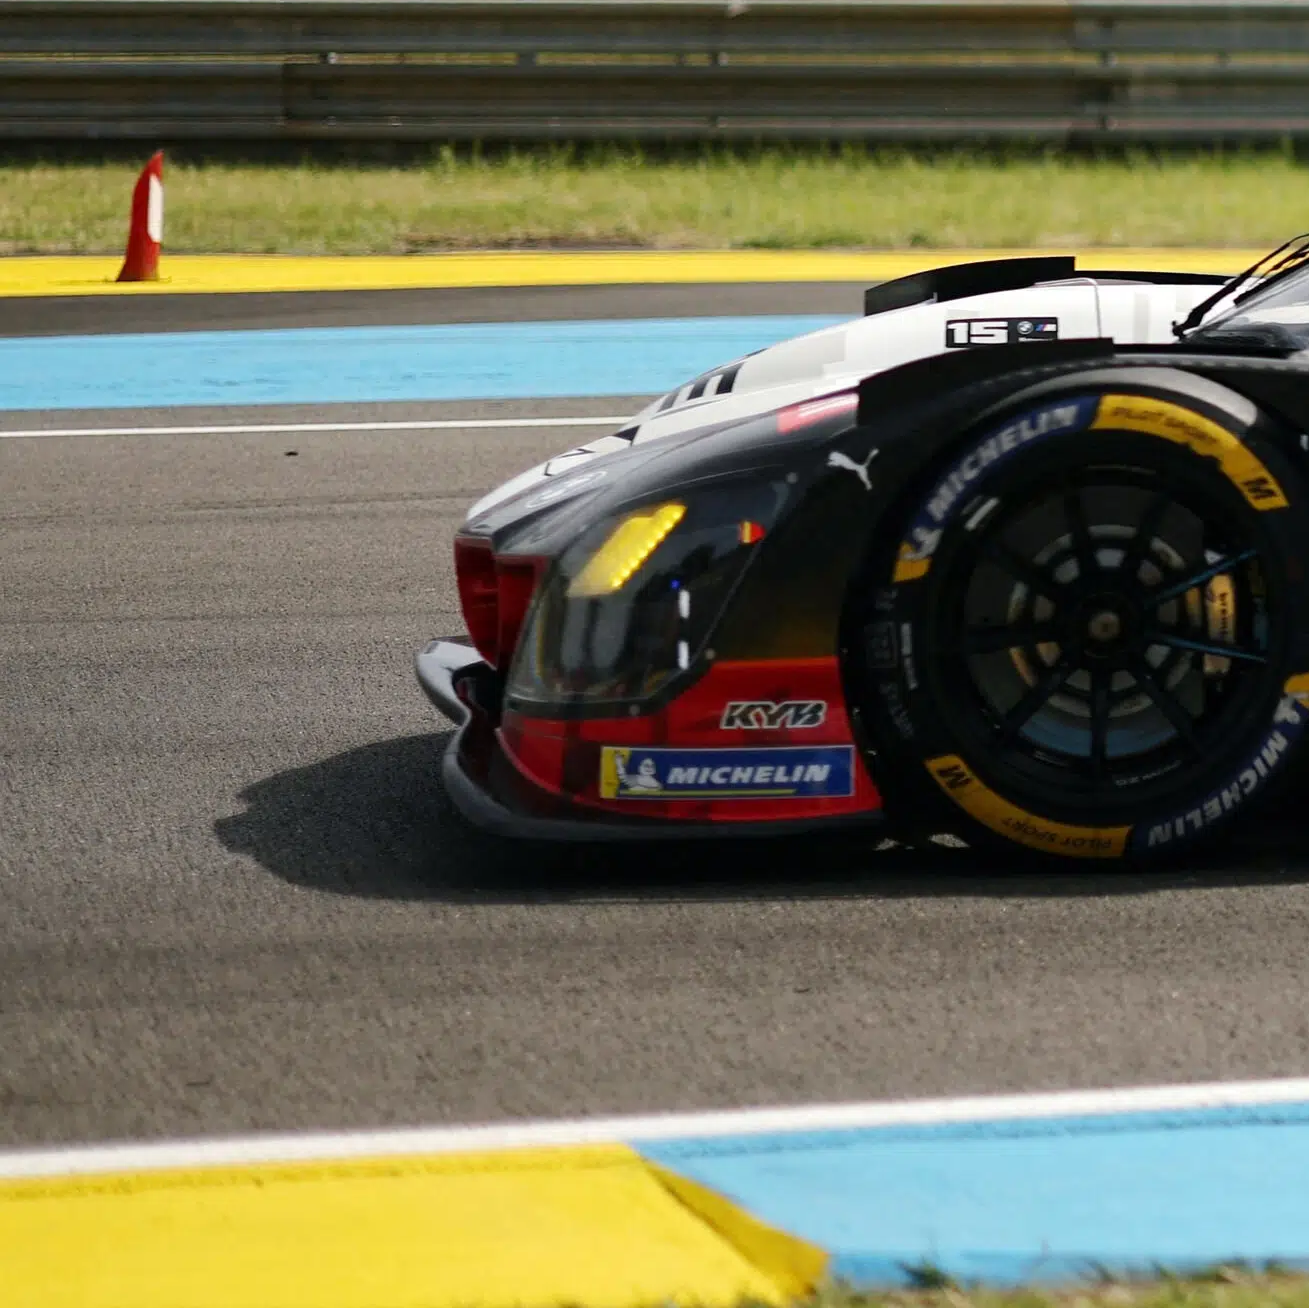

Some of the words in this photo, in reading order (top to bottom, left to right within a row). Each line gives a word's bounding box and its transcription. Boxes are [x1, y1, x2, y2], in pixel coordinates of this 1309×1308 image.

[946, 321, 1008, 344] 15
[926, 404, 1079, 521] MICHELIN
[720, 701, 826, 730] KYB
[667, 764, 830, 785] MICHELIN
[1148, 730, 1289, 848] MICHELIN
